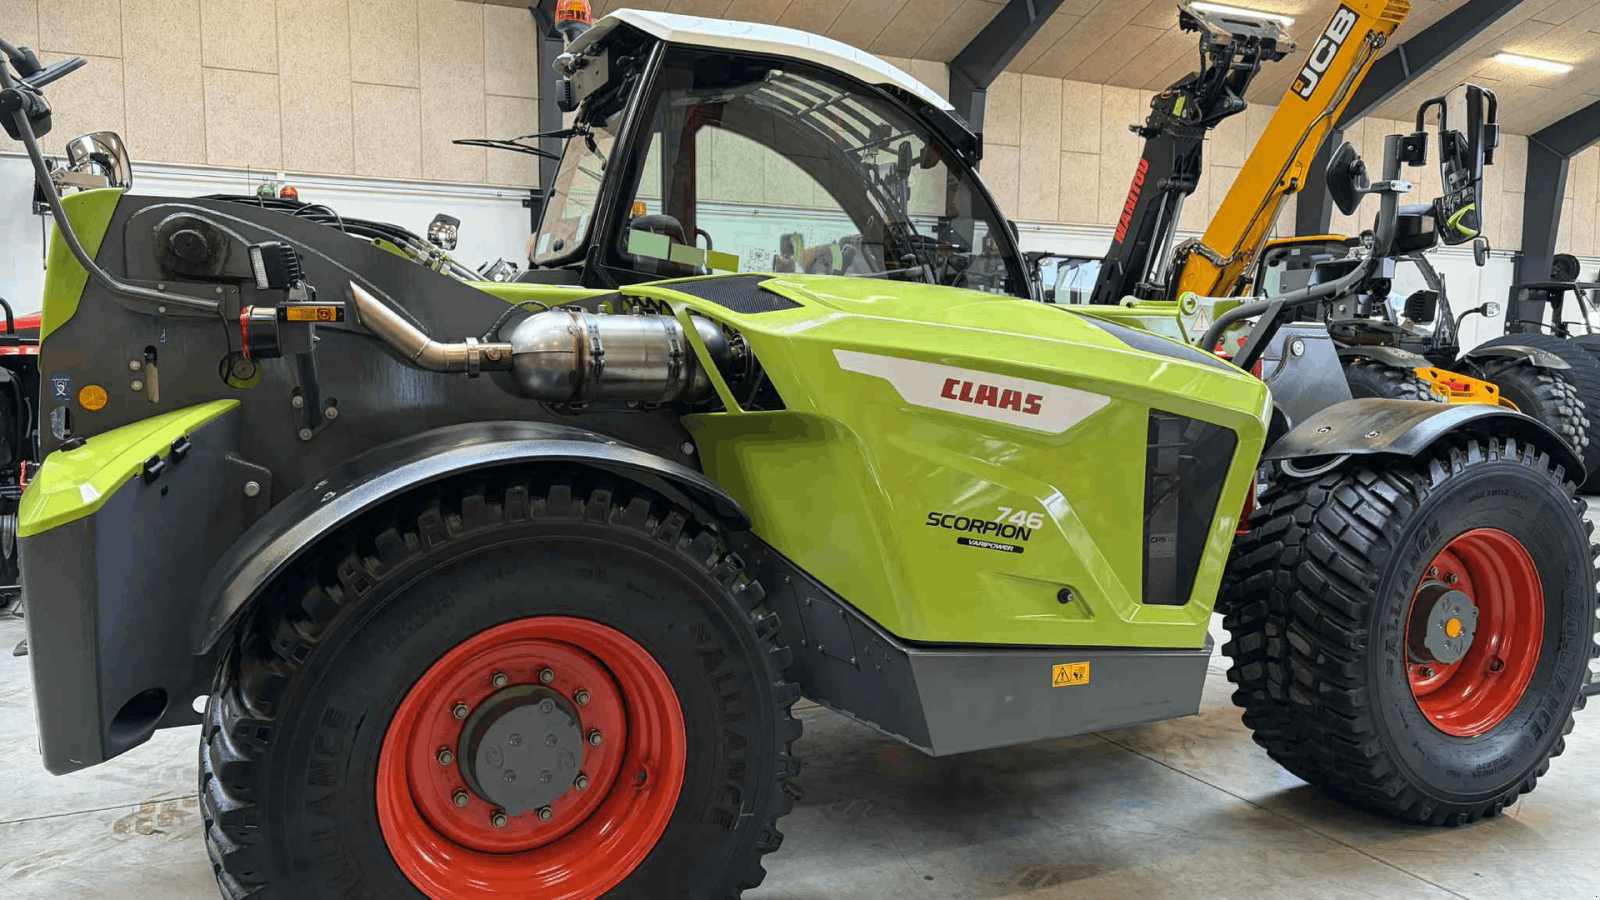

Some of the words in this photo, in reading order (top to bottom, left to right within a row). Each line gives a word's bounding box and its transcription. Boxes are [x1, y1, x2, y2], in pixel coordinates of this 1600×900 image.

[1300, 8, 1356, 97] JCB
[1114, 158, 1149, 245] MANITOU
[940, 377, 1043, 415] CLAAS
[925, 511, 1032, 541] SCORPION
[968, 539, 1014, 551] VARIPOWER
[993, 506, 1044, 530] 746
[1384, 518, 1440, 659] ALLIANCE
[690, 646, 748, 830] ALLIANCE
